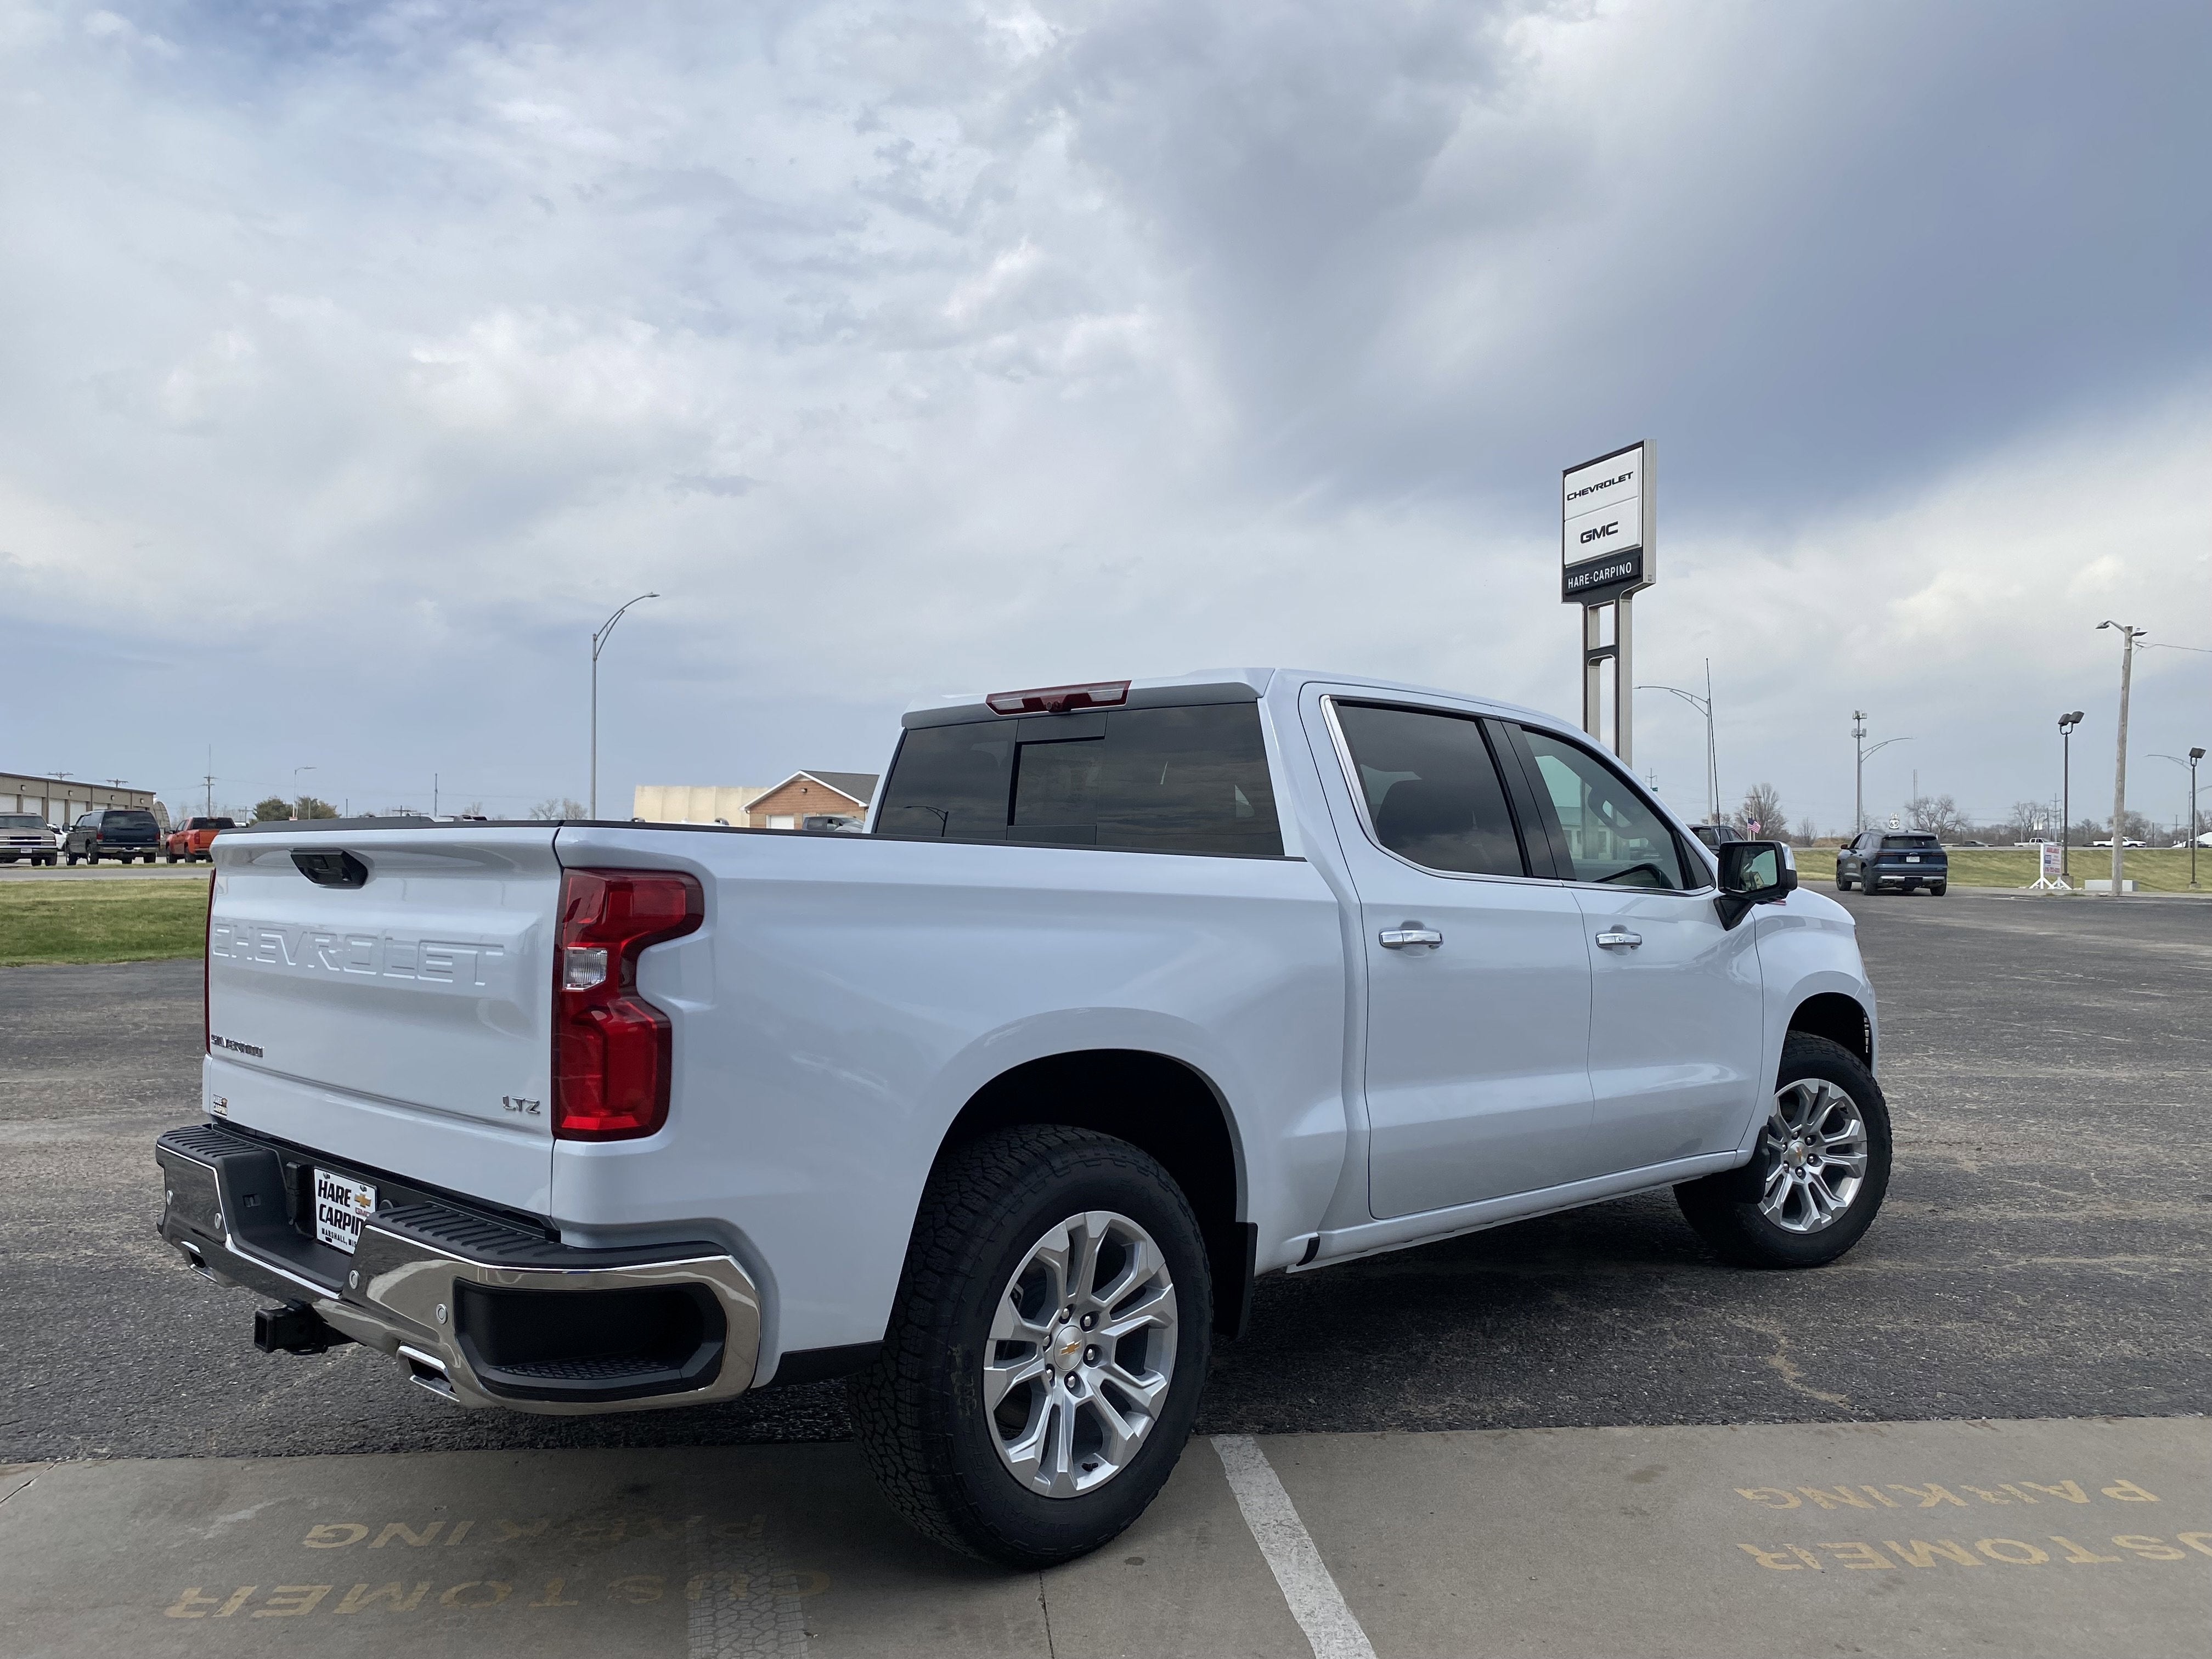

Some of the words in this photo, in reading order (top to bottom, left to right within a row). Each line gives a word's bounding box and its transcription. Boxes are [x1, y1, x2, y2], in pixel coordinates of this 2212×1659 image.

[1567, 471, 1633, 501] CHEVROLET
[1580, 521, 1618, 544] GMC
[1567, 561, 1632, 589] HARE-CARPINO
[212, 923, 504, 986] CHEVROLET
[503, 1095, 540, 1114] LTZ
[318, 1179, 352, 1207] HARE
[319, 1203, 363, 1236] CARPIN
[321, 1227, 347, 1245] MARSHALL,
[1734, 1479, 2162, 1510] PARKING
[302, 1514, 766, 1549] PARKING
[164, 1570, 831, 1618] CUSTOMER
